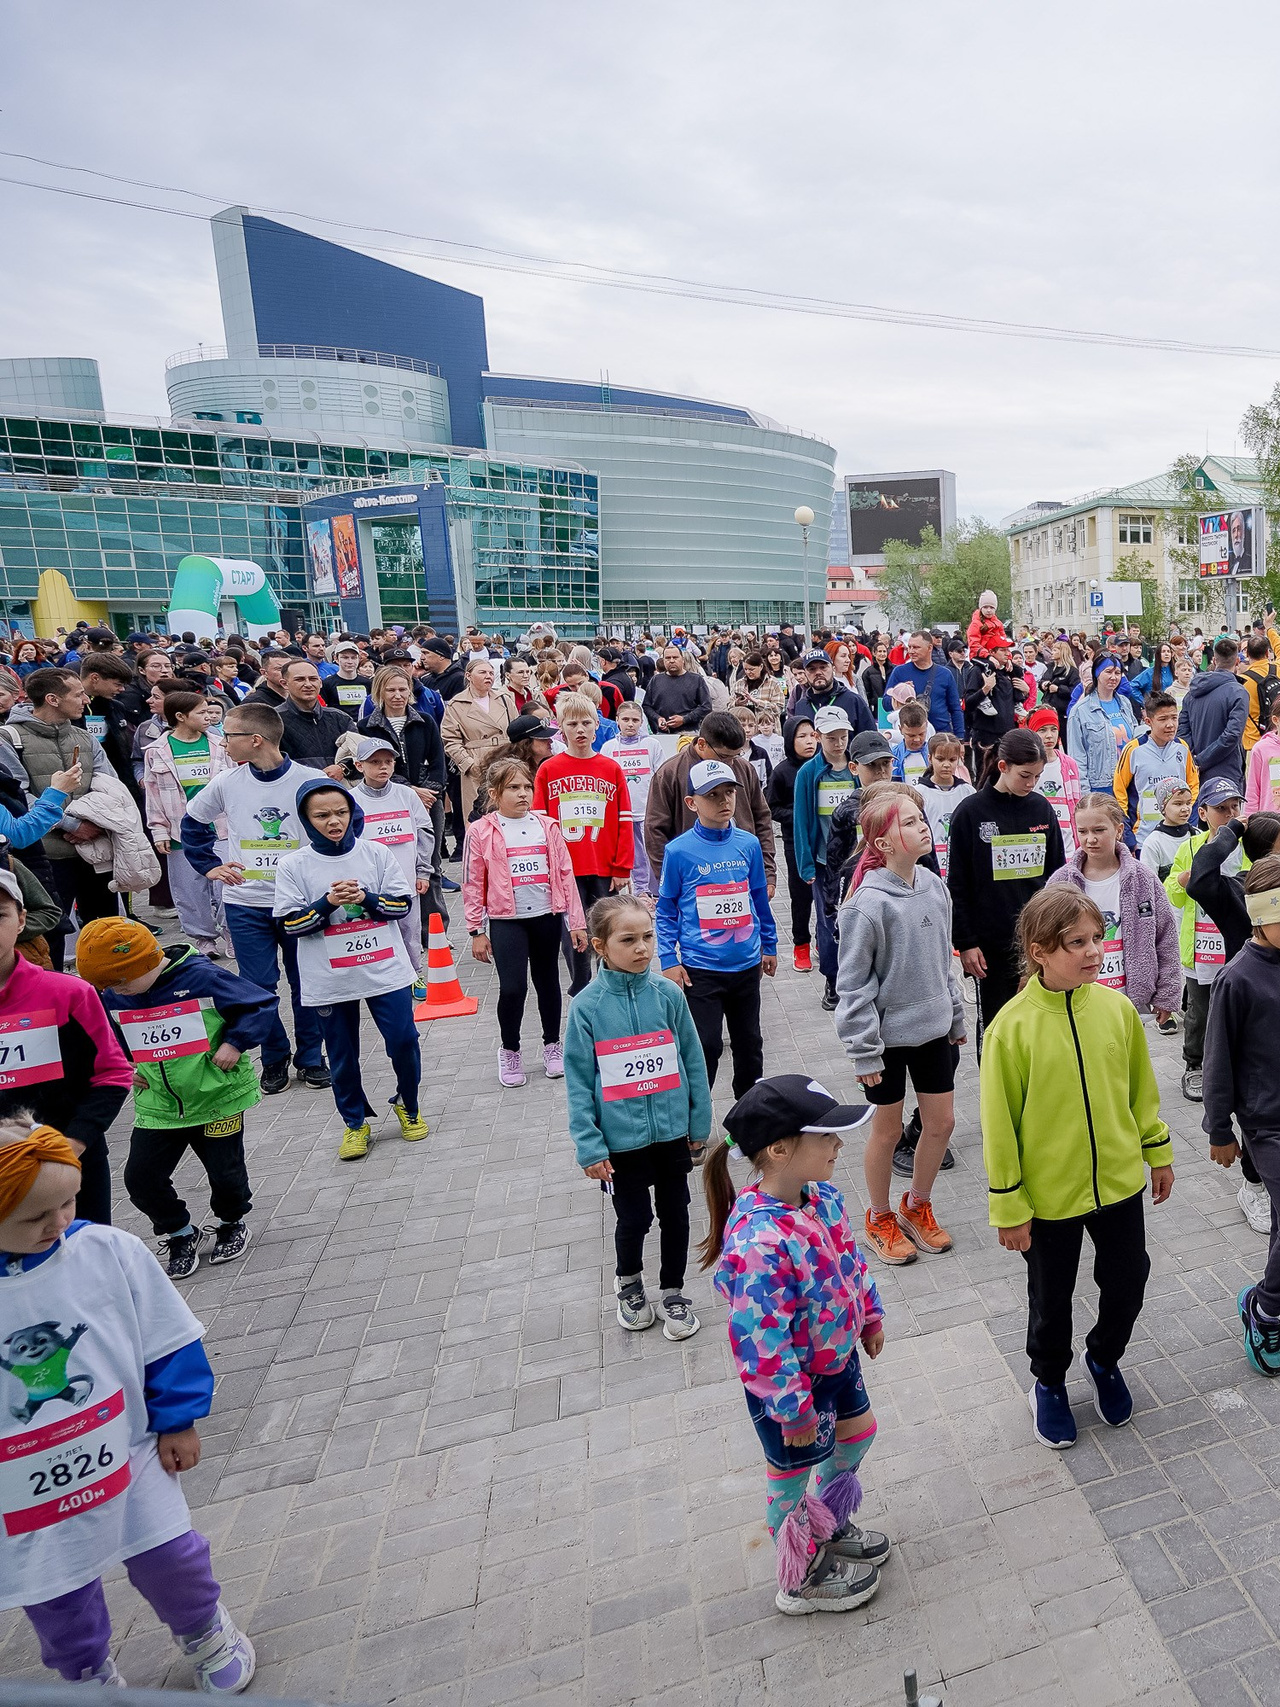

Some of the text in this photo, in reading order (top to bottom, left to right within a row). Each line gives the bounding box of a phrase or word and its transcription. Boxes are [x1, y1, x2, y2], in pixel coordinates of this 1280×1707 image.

[231, 569, 256, 586] СТАРТ
[623, 760, 642, 768] 2665
[548, 775, 617, 801] ENERGY
[574, 806, 598, 816] 3158
[377, 823, 403, 834] 2664
[255, 856, 279, 868] 314
[712, 860, 746, 870] ЮГОРИЯ
[1008, 852, 1034, 865] 3141
[512, 862, 539, 873] 2805
[714, 902, 744, 915] 2828
[723, 918, 740, 926] 400м
[345, 936, 380, 952] 2661
[1196, 938, 1222, 951] 2705
[356, 954, 376, 963] 400м
[1200, 954, 1215, 962] 400м
[142, 1026, 182, 1046] 2669
[0, 1044, 26, 1065] 71
[152, 1048, 176, 1060] 400м
[624, 1056, 664, 1078] 2989
[0, 1075, 16, 1085] 0м
[636, 1081, 659, 1092] 400м
[18, 1439, 38, 1452] СБЕР
[46, 1444, 84, 1464] 7-9 ЛЕТ
[28, 1442, 114, 1496] 2826
[57, 1488, 106, 1514] 400м
